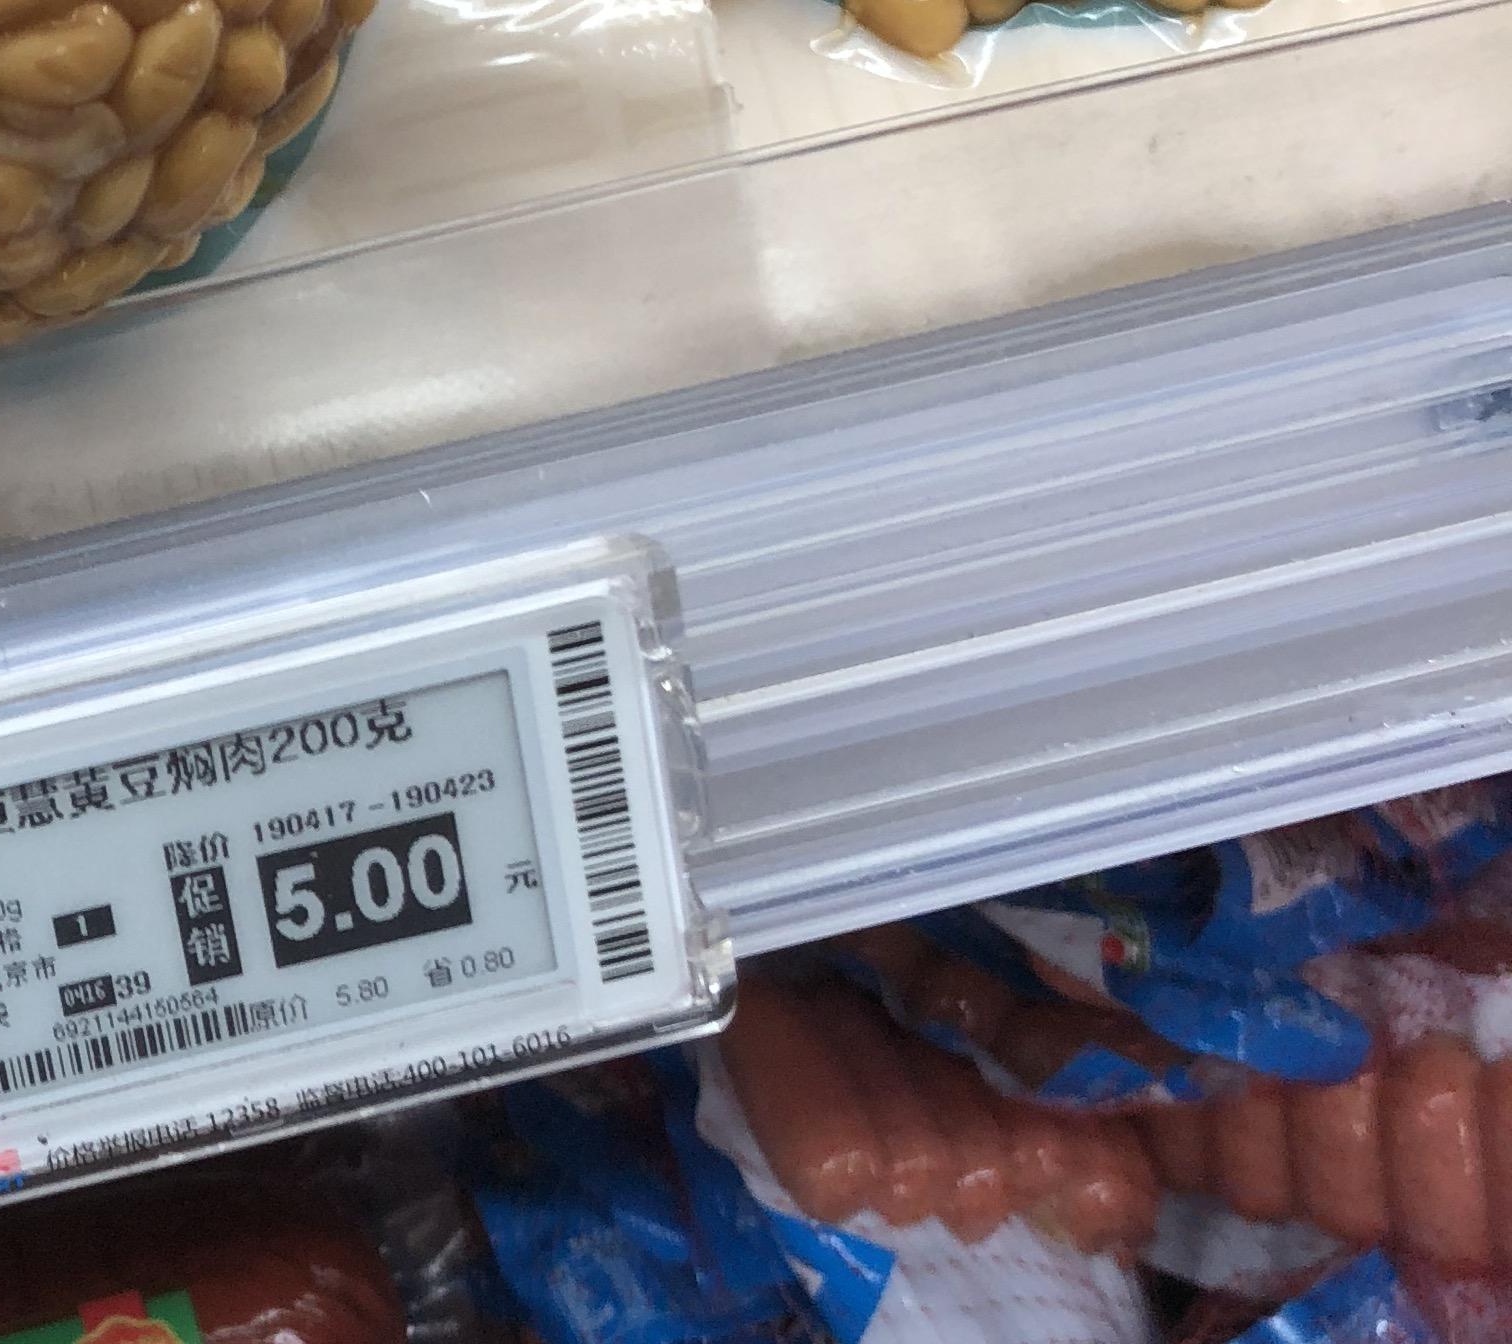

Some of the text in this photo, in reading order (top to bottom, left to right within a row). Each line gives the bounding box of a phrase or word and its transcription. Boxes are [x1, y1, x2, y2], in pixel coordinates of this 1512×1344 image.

[274, 833, 463, 942] 5.00
[504, 859, 539, 894] 元
[178, 871, 232, 969] 促销
[461, 946, 516, 978] 0.80
[52, 986, 220, 1043] 6921144150564
[250, 976, 390, 1033] 原价 5.80
